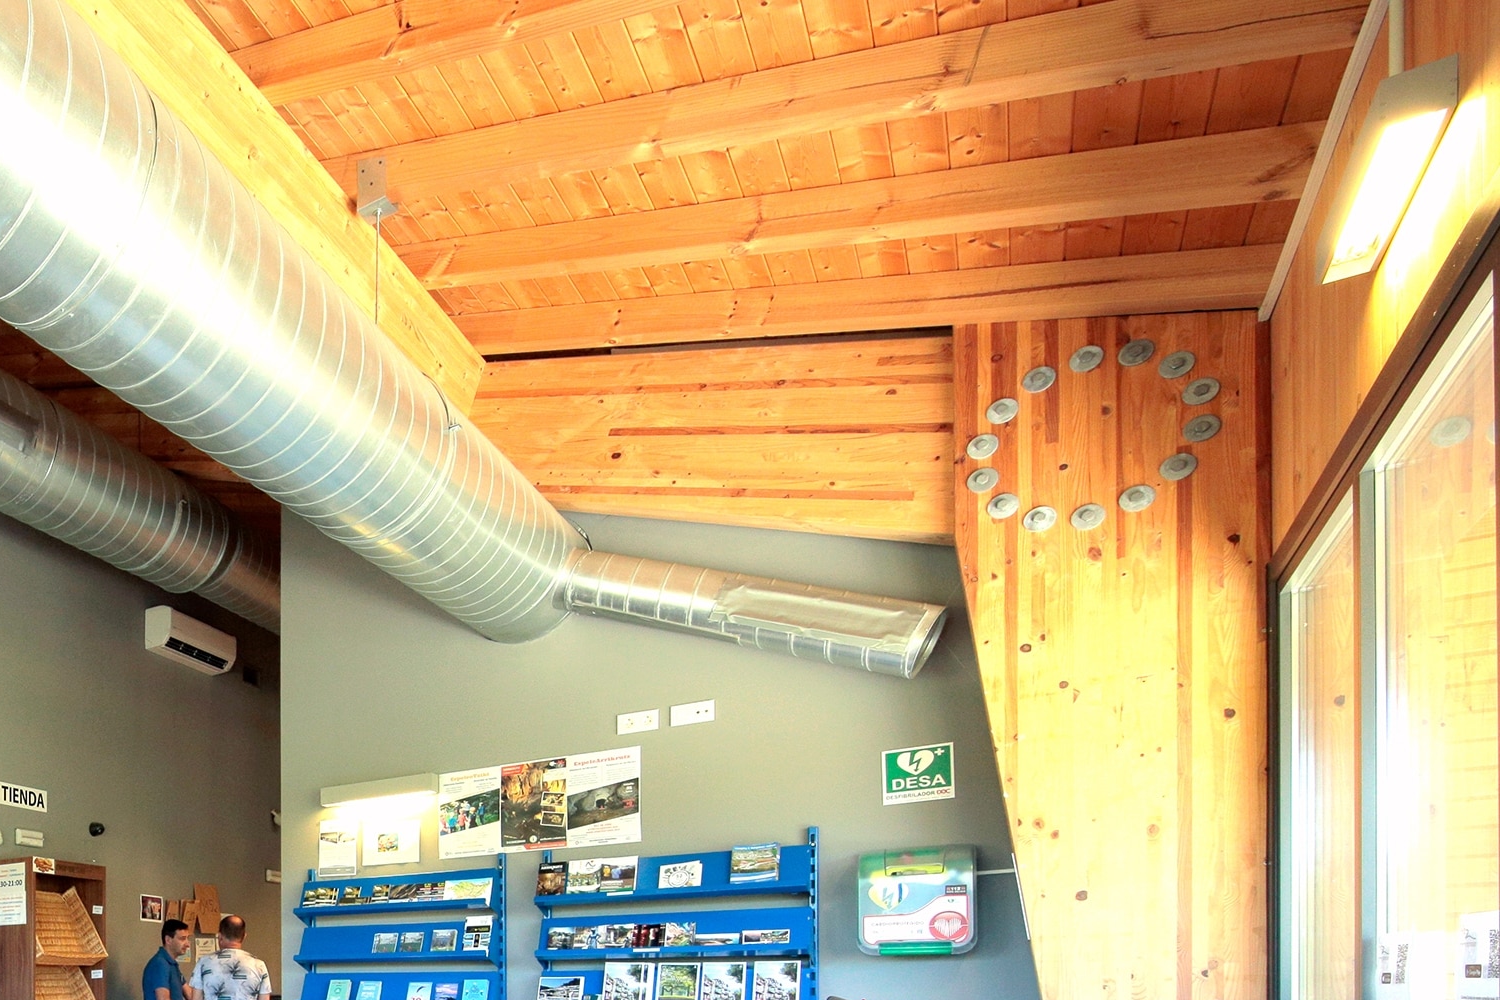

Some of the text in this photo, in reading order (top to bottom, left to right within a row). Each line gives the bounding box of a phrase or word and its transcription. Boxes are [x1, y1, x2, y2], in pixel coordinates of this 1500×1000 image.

[891, 773, 947, 791] DESA
[1, 785, 45, 809] TIENDA
[885, 790, 935, 800] DESFIBRILADOR
